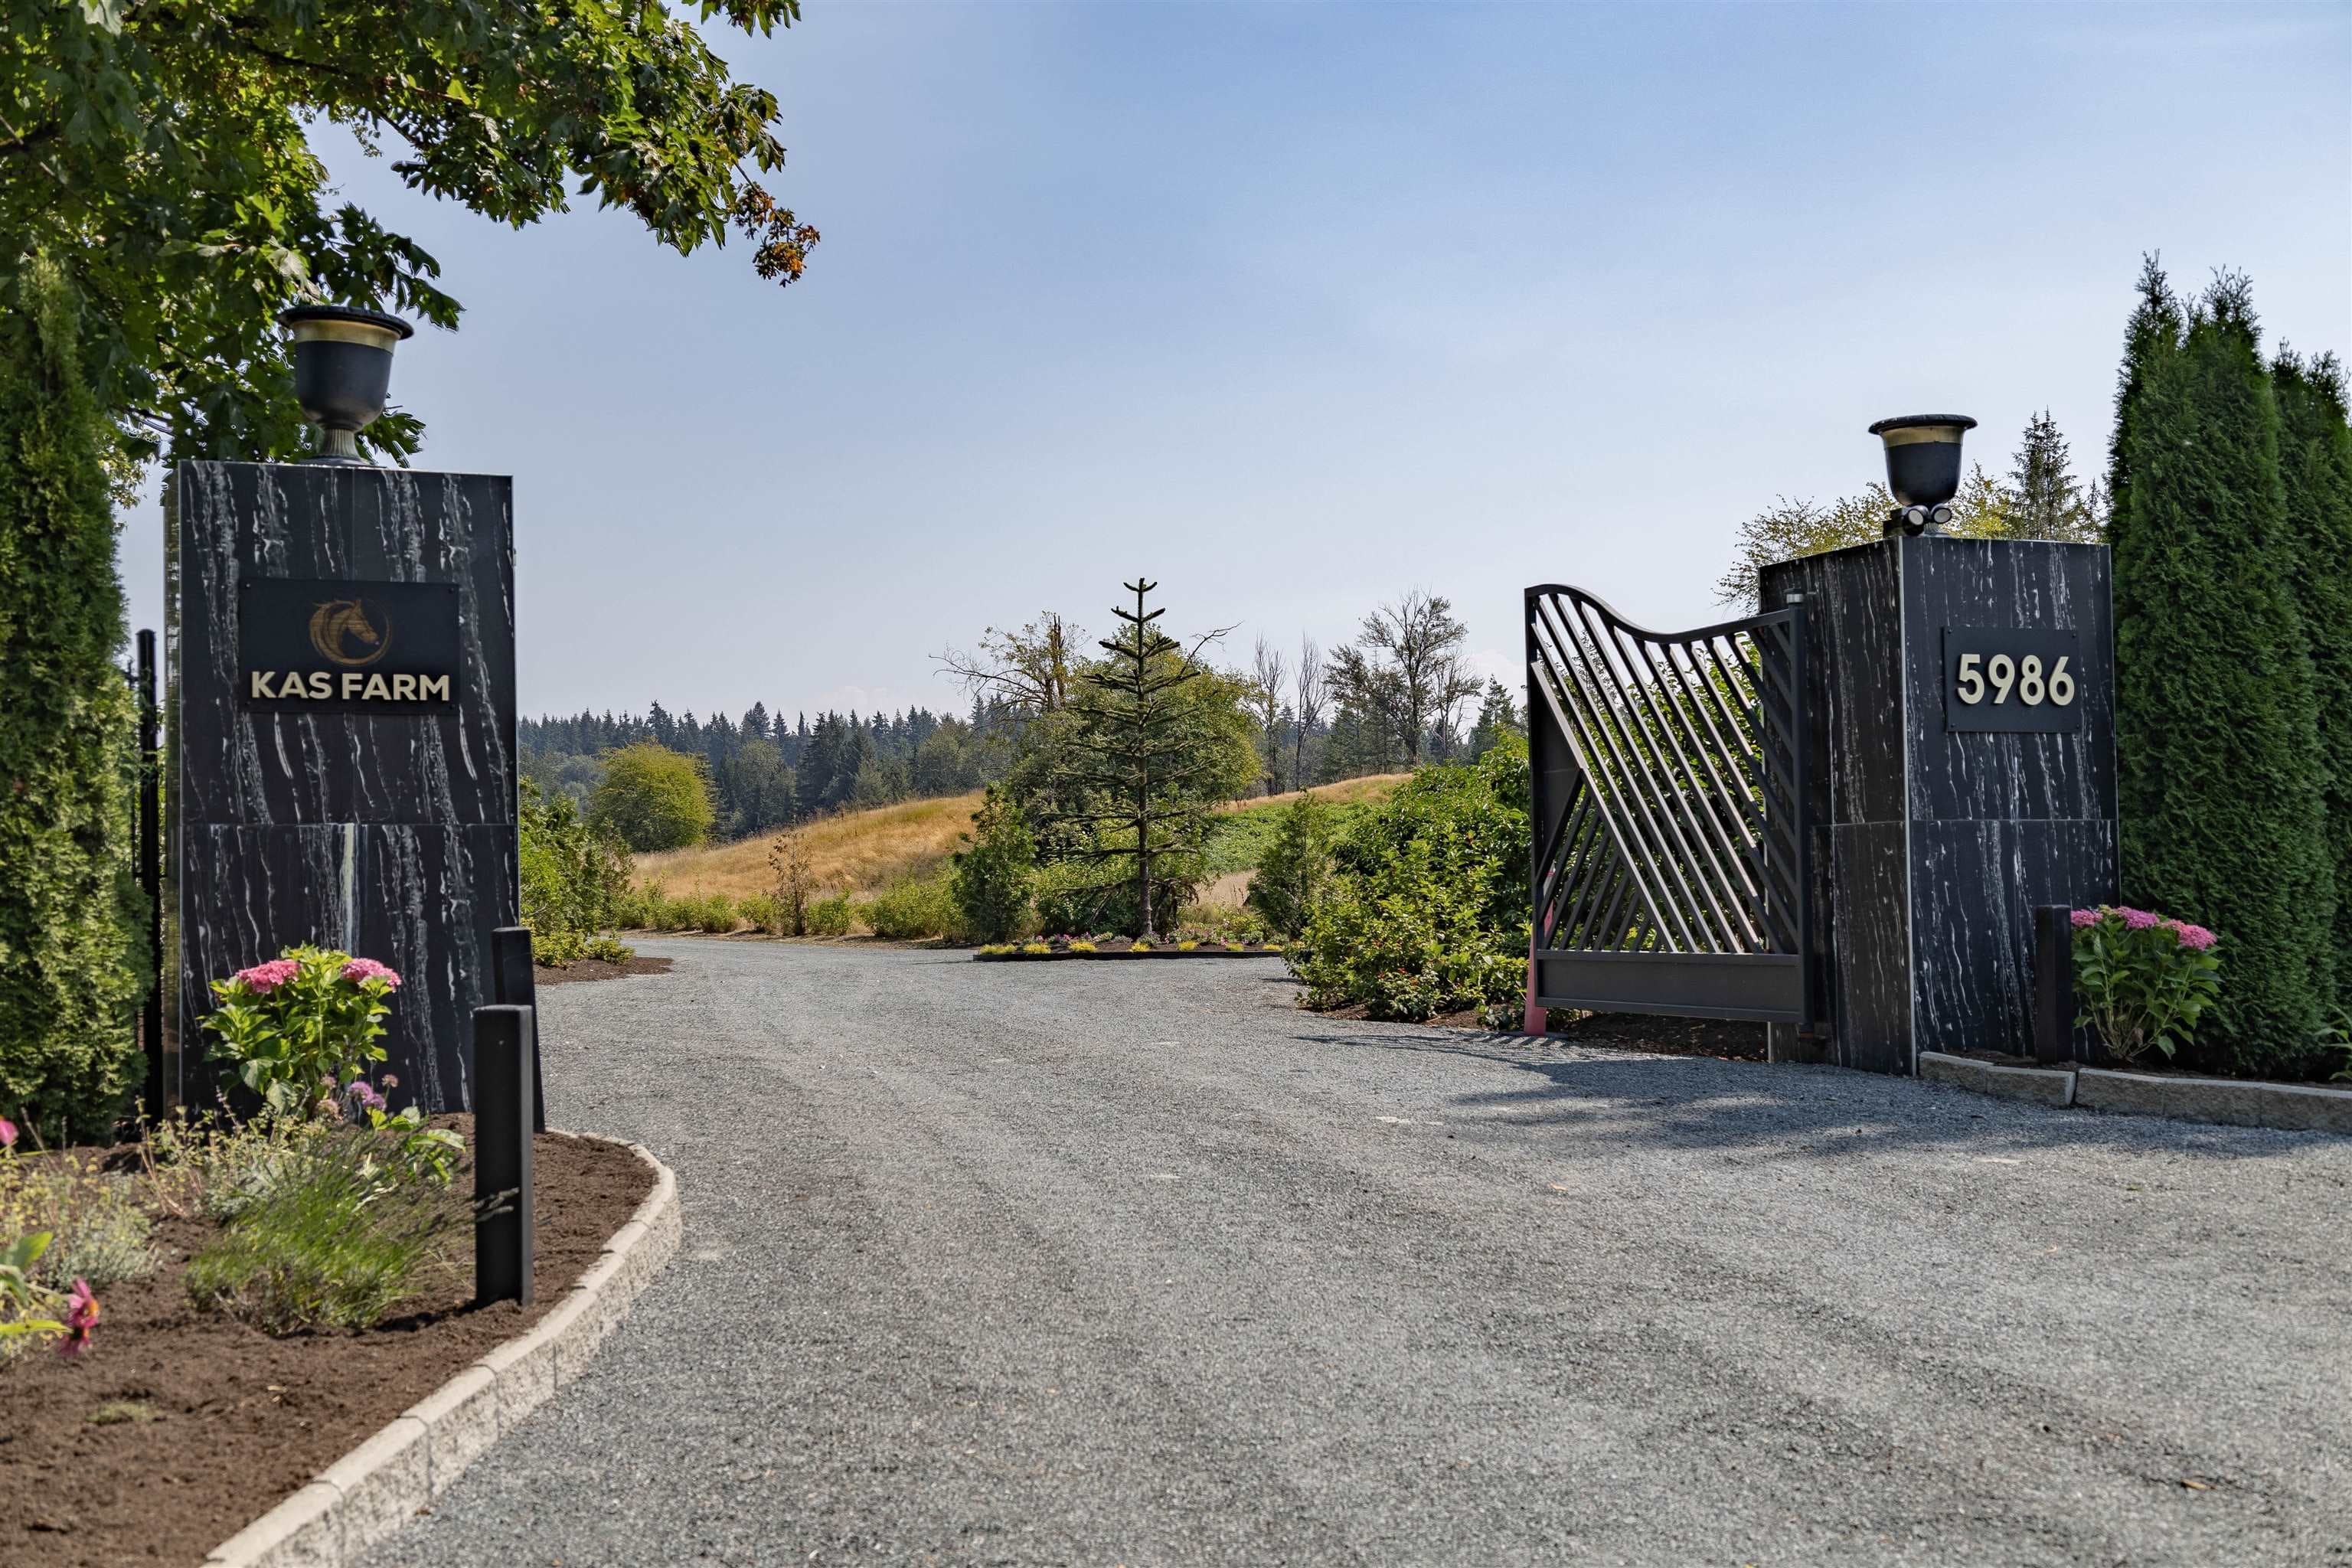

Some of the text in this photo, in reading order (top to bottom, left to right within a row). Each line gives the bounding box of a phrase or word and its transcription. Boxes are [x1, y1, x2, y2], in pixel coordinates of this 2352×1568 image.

[251, 671, 450, 701] KAS FARM
[1957, 653, 2076, 706] 5986
